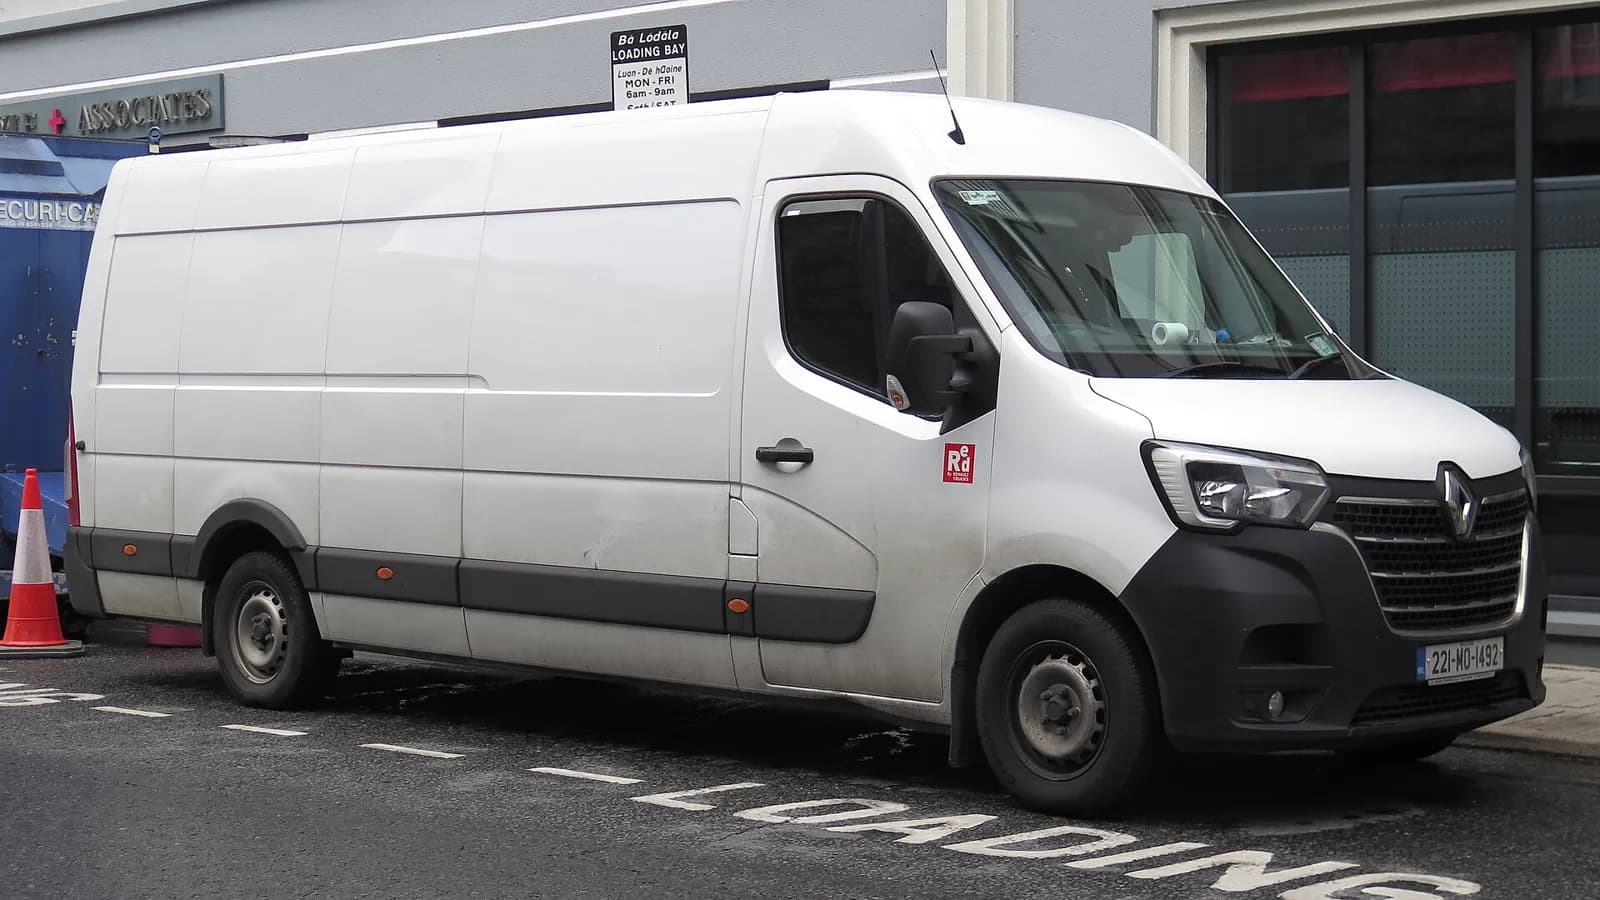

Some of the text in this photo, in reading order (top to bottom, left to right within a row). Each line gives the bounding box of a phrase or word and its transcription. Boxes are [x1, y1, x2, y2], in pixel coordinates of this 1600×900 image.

[612, 43, 685, 61] LOADING BAY
[625, 78, 650, 89] MON
[658, 75, 675, 86] FRI
[626, 90, 647, 99] 6am
[654, 87, 675, 97] 9am
[78, 88, 210, 133] ASSOCIATES
[1431, 643, 1499, 675] 221-MO-1492
[629, 782, 1481, 900] LOADING
